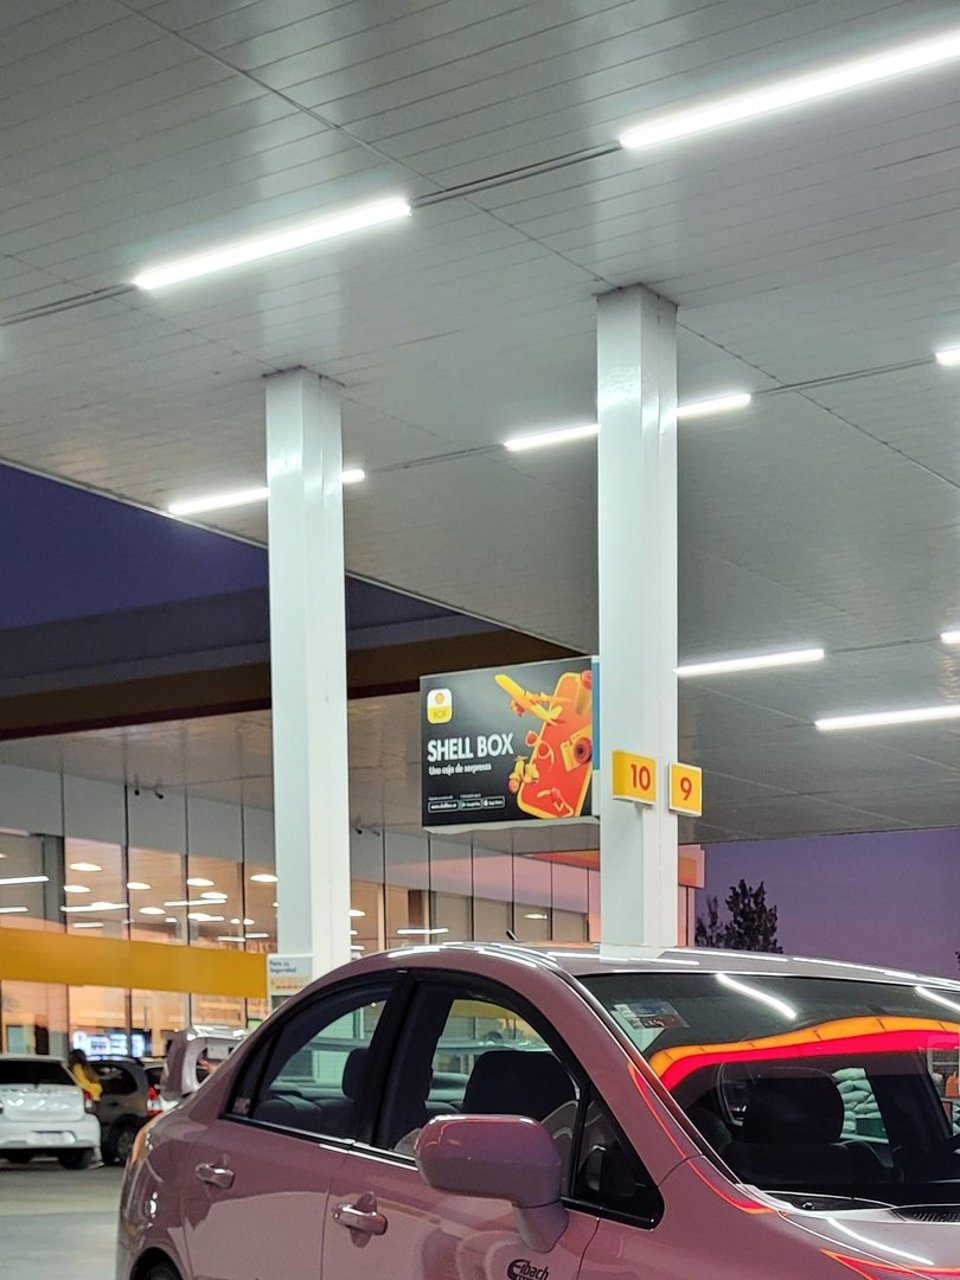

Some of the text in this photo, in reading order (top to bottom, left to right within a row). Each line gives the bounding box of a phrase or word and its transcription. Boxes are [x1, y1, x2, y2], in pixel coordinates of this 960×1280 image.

[427, 733, 514, 762] SHELL BOX
[630, 763, 651, 791] 10
[679, 776, 692, 801] 9
